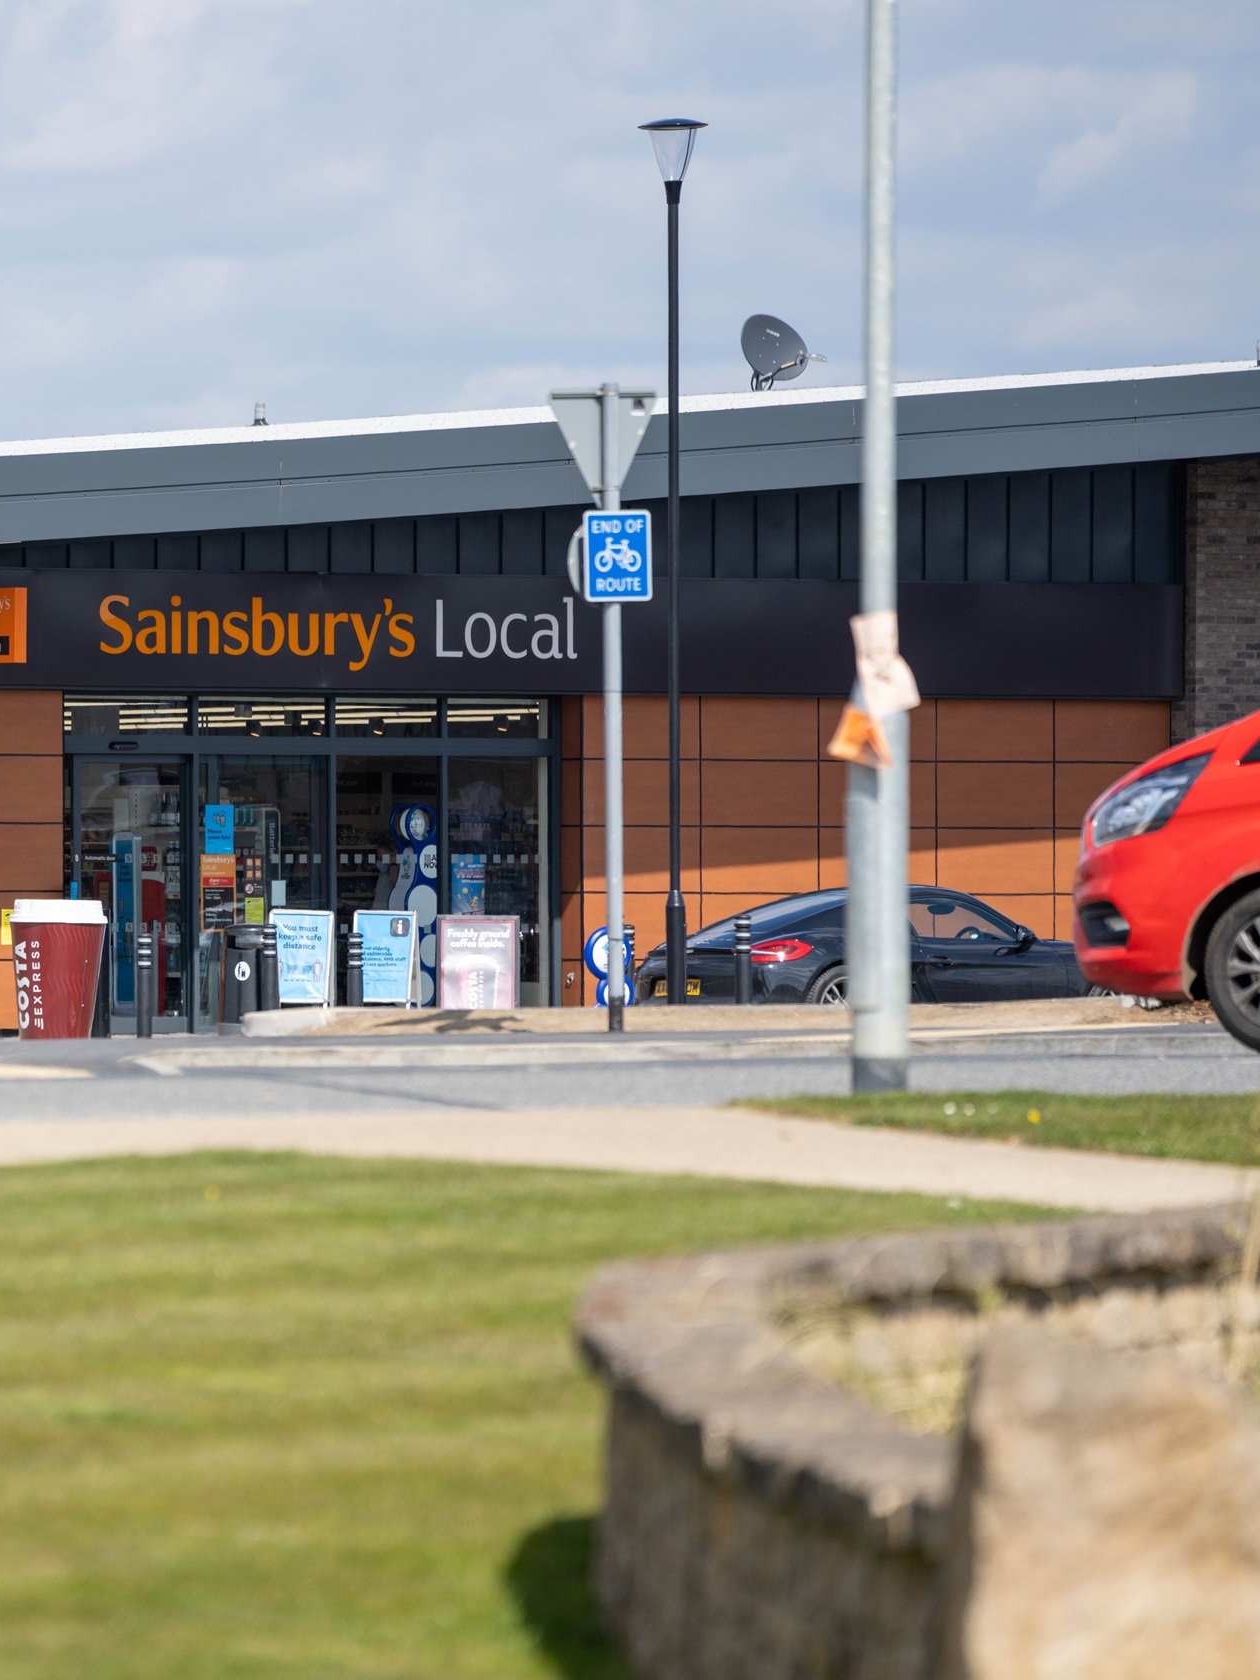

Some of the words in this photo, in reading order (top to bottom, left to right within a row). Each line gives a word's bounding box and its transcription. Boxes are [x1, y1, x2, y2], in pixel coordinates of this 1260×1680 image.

[591, 520, 622, 534] END
[624, 518, 644, 533] OF
[596, 577, 642, 592] ROUTE
[99, 594, 415, 672] Sainsbury's
[435, 597, 578, 660] Local
[278, 933, 297, 942] keep
[447, 928, 478, 941] Freshly
[479, 929, 510, 940] ground
[450, 939, 477, 948] coffee
[478, 939, 505, 948] inside.
[14, 941, 30, 1030] COSTA
[31, 940, 43, 1015] EXPRESS
[468, 971, 478, 1009] COSTA
